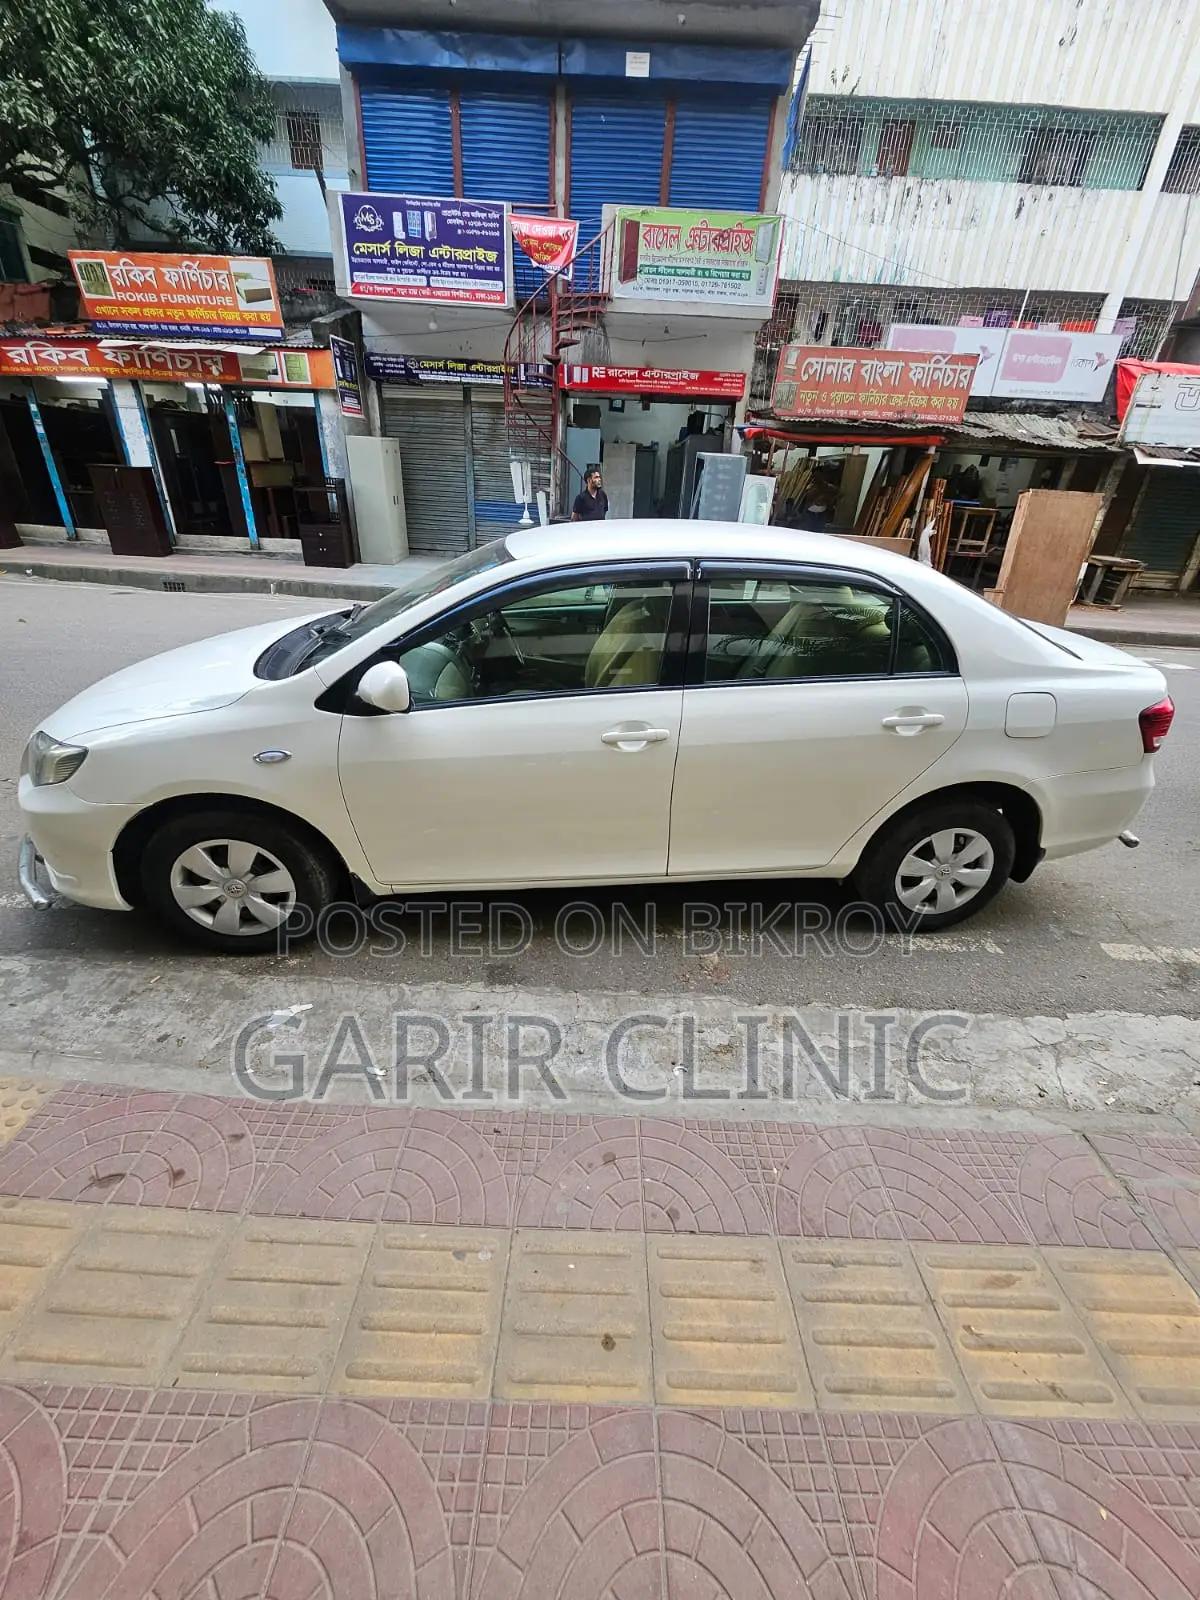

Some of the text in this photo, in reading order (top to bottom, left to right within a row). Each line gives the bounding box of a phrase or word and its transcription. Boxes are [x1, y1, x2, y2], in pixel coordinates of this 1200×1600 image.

[642, 219, 756, 256] রাসেল এন্টারপ্রাইজ
[354, 240, 499, 264] মেসার্স লিজা এন্টারপ্রাইজ
[108, 258, 232, 292] রকিব ফার্ণিচার
[116, 291, 234, 306] ROKIB FURNITURE
[1, 341, 90, 366] রকিব
[420, 360, 445, 370] মেসার্স
[447, 360, 466, 372] লিজা
[592, 367, 606, 378] RE
[606, 367, 700, 381] রাসেল এন্টারপ্রাইজ
[801, 353, 975, 390] সোনার বাংলা ফার্নিচার
[800, 389, 818, 407] নতুন
[830, 391, 857, 408] পুরাতন
[859, 388, 888, 407] ফার্নিচার
[931, 396, 945, 409] করা
